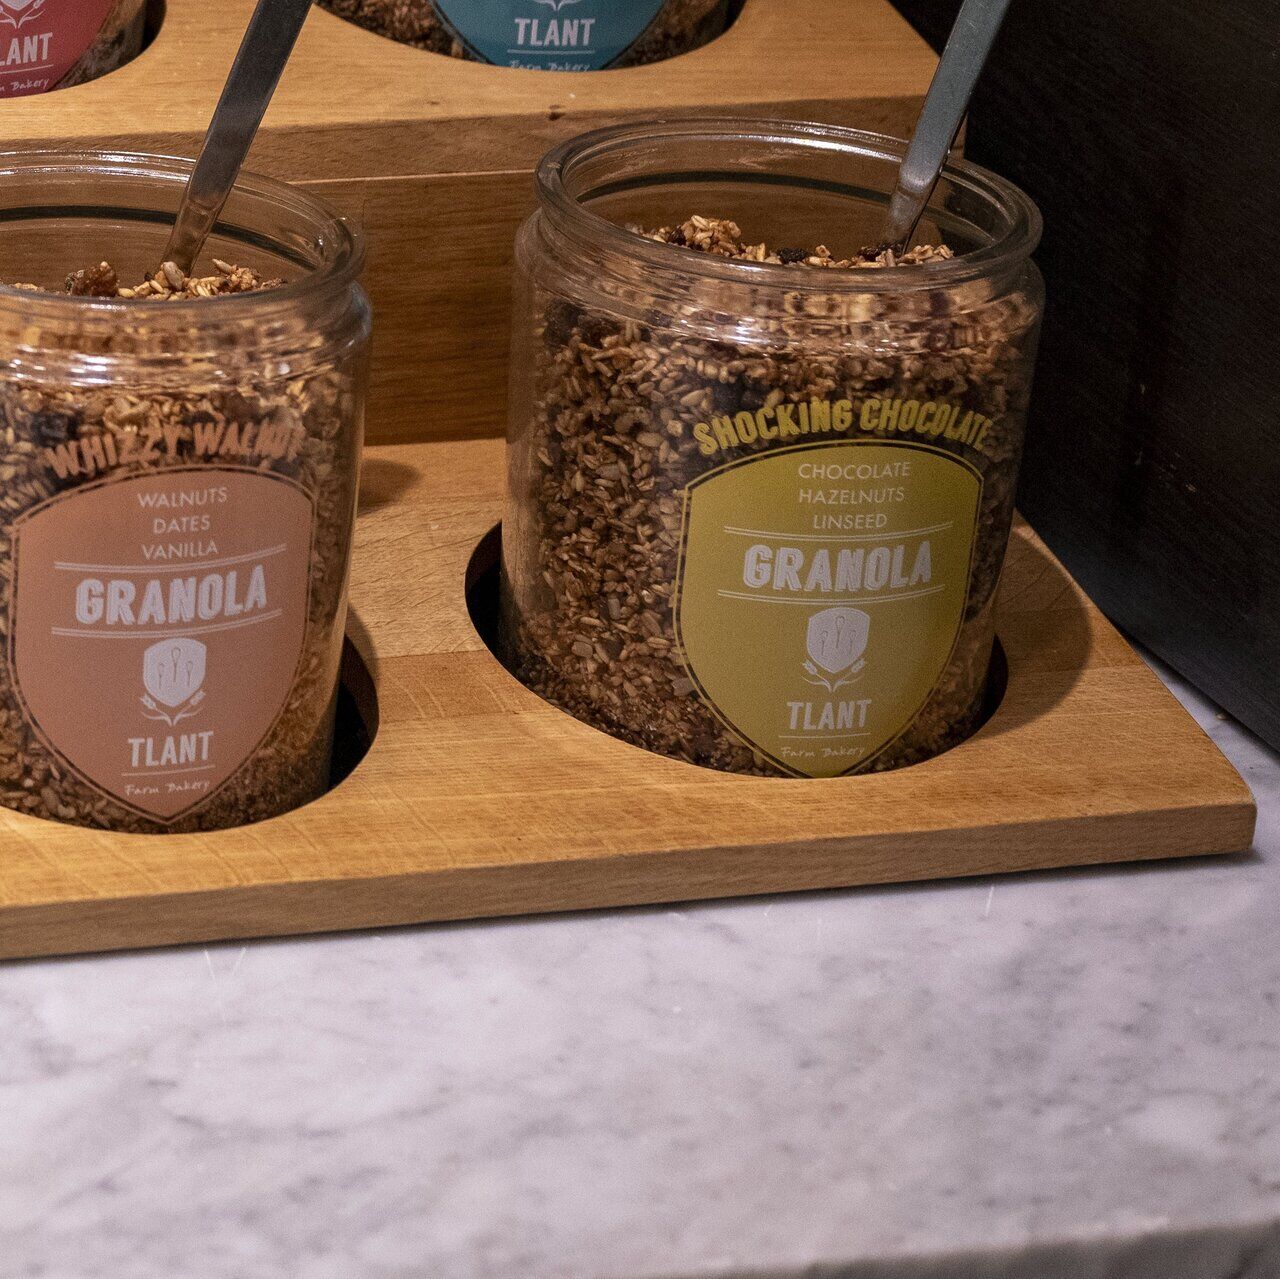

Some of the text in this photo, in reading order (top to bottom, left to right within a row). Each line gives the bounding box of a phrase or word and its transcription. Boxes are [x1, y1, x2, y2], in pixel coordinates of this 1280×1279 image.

[515, 18, 596, 46] TLANT
[11, 77, 50, 91] Bakery
[693, 397, 993, 455] SHOCKING CHOCOLATE
[42, 422, 187, 479] WHIZZY
[798, 461, 912, 480] CHOCOLATE
[138, 487, 228, 508] WALNUTS
[798, 486, 906, 505] HAZELNUTS
[153, 516, 210, 535] DATES
[813, 513, 888, 529] LINSEED
[142, 540, 219, 561] VANILLA
[743, 540, 933, 593] GRANOLA
[75, 565, 268, 626] GRANOLA
[787, 699, 872, 731] TLANT
[128, 731, 215, 768] TLANT
[781, 745, 866, 758] Farm Bakery
[124, 778, 210, 797] Farm Bakery
